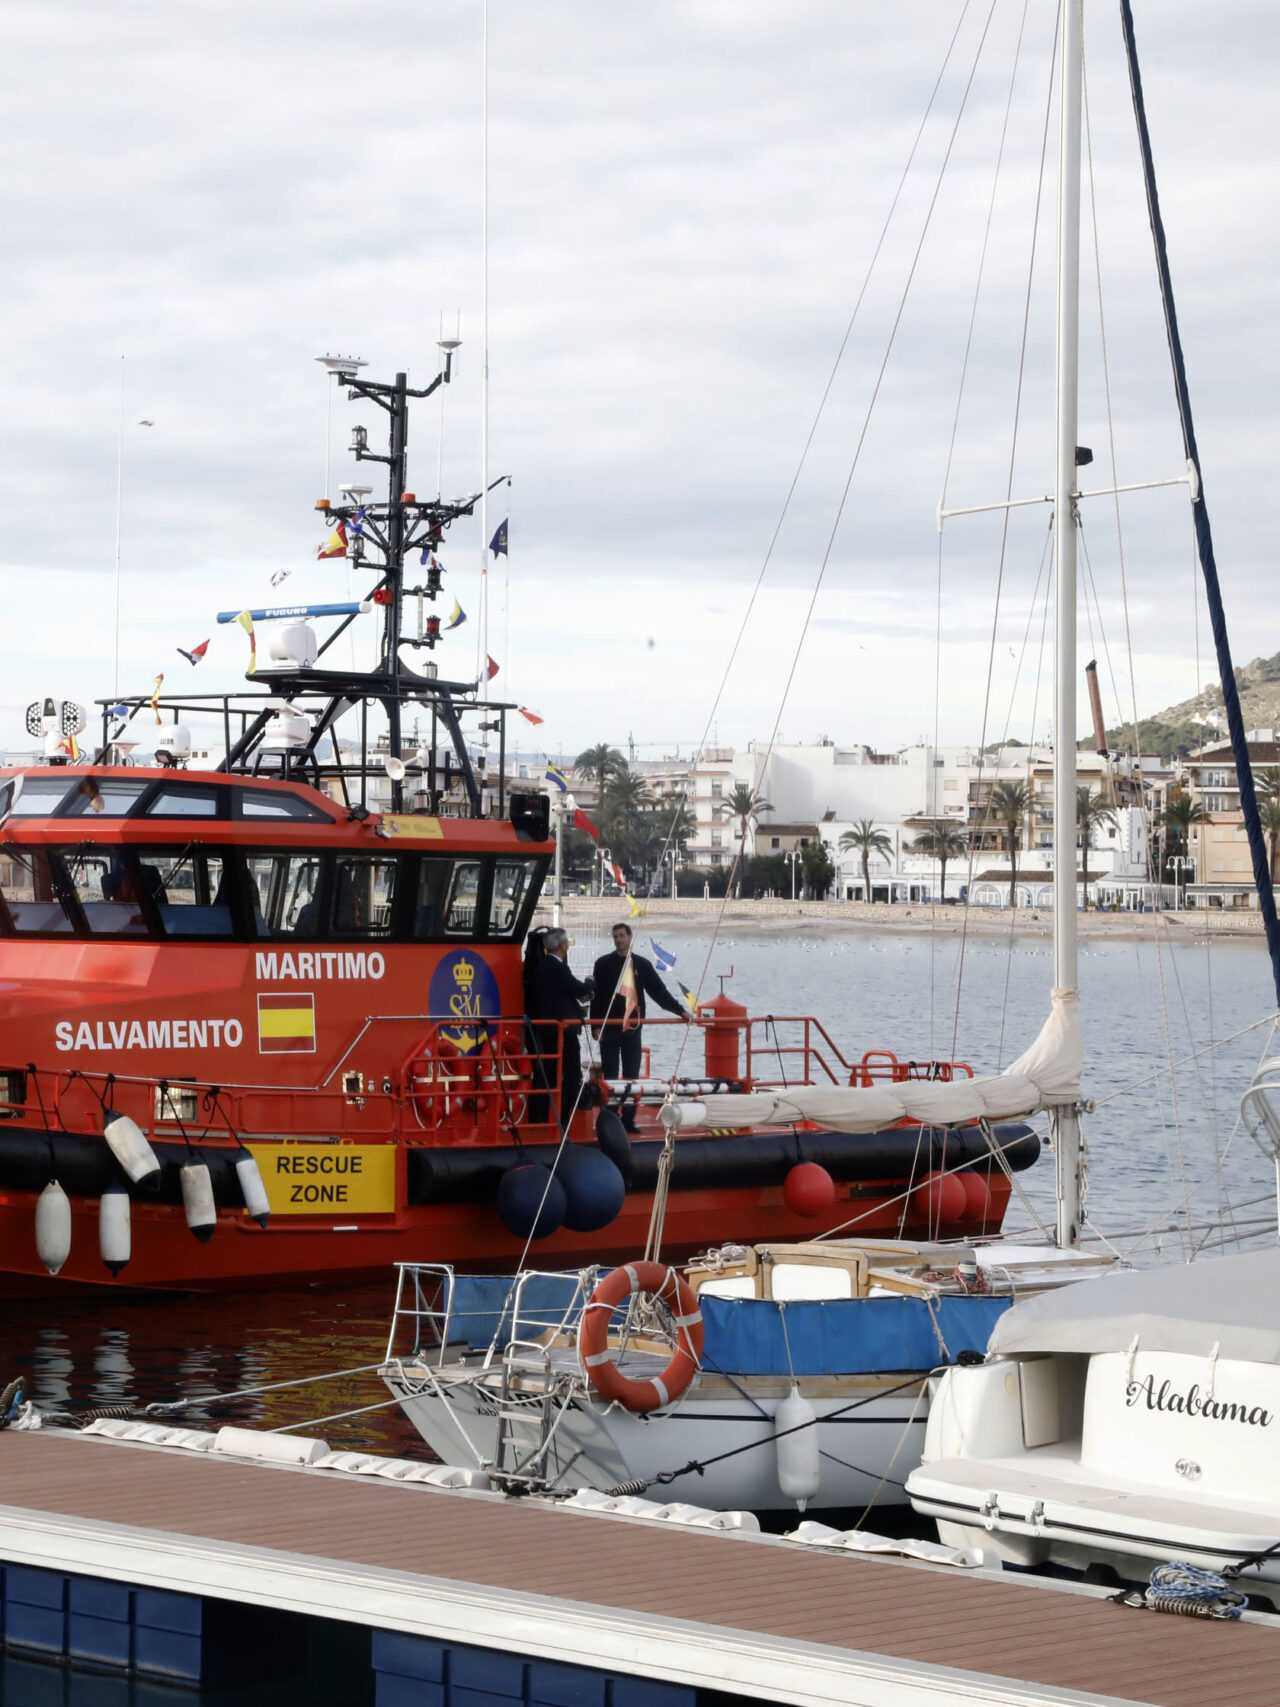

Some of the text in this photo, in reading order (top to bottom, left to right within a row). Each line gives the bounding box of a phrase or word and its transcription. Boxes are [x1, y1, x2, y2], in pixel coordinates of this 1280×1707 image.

[265, 607, 308, 617] FURUNO
[255, 952, 386, 980] MARITIMO
[55, 1019, 243, 1051] SALVAMENTO
[277, 1156, 362, 1174] RESCUE
[290, 1184, 348, 1203] ZONE
[1126, 1374, 1274, 1427] Alabama
